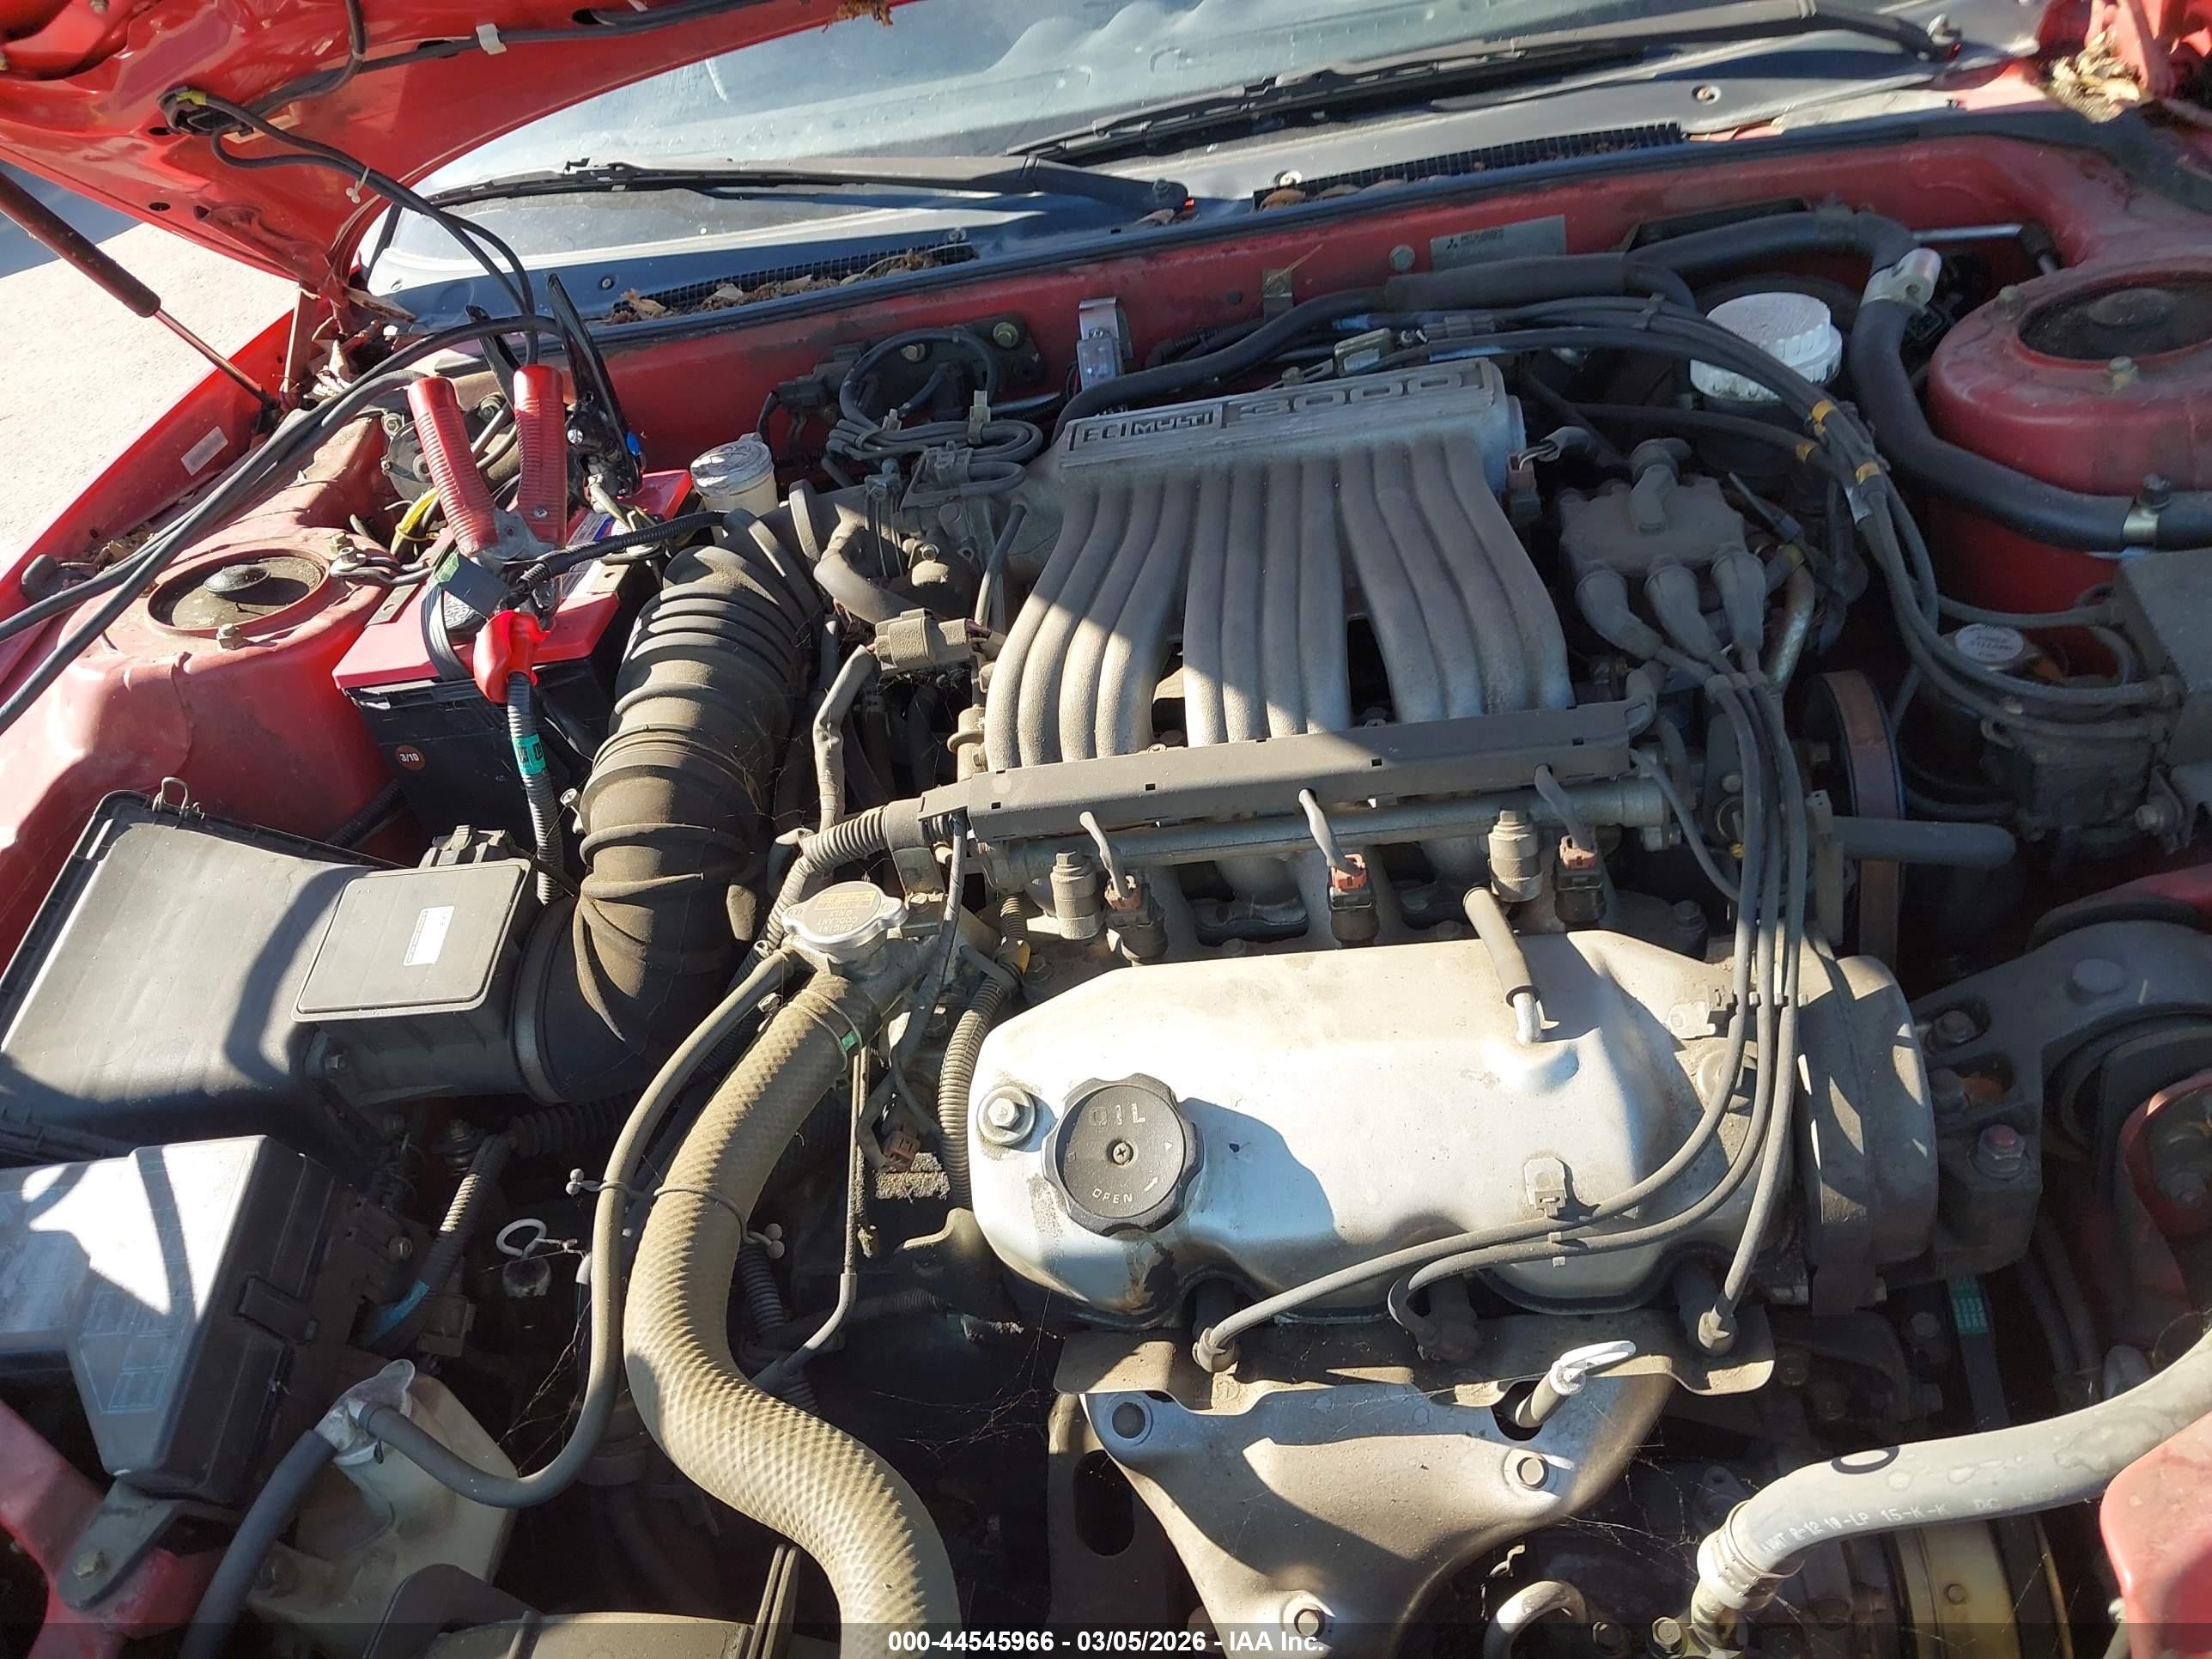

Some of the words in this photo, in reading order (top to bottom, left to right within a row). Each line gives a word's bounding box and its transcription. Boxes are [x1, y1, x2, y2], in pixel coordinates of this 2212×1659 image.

[1083, 423, 1127, 442] ECI
[1133, 411, 1214, 435] MULTI
[1238, 374, 1461, 420] 3000
[399, 753, 420, 762] 3/10
[817, 916, 859, 925] COOLANT
[817, 924, 854, 933] ENGINE
[1089, 1103, 1146, 1127] OIL
[1092, 1188, 1133, 1204] OPEN
